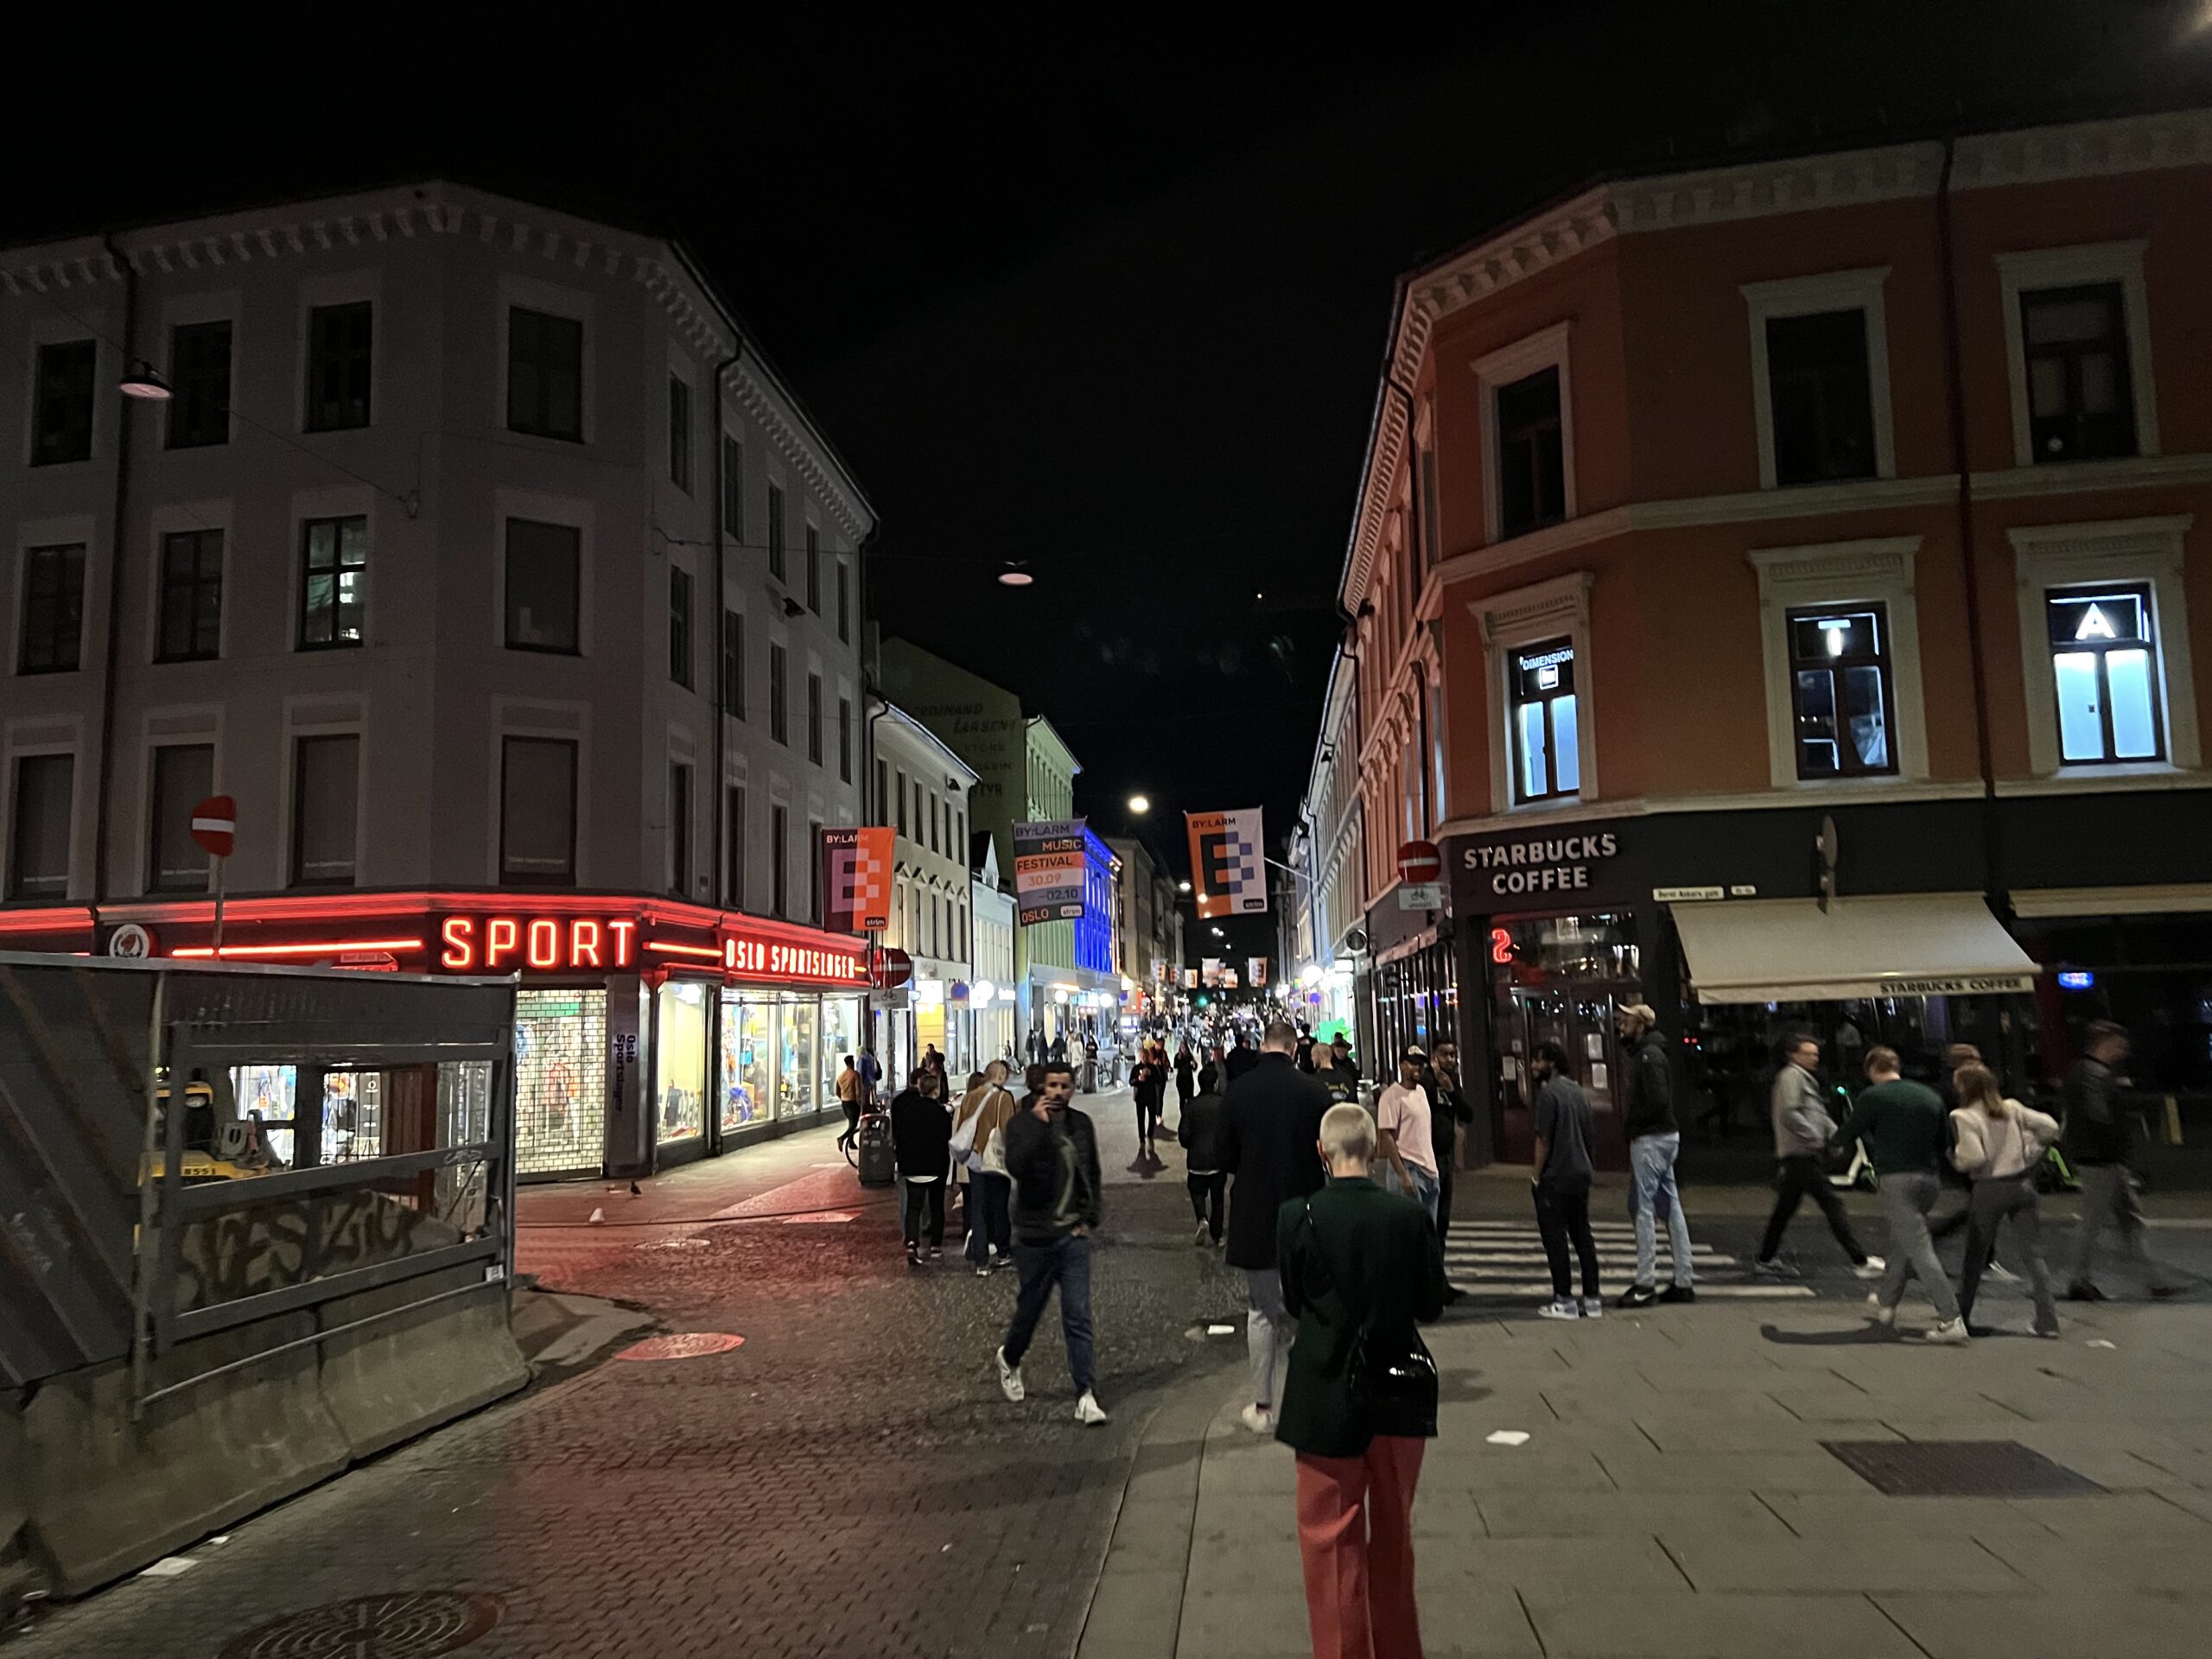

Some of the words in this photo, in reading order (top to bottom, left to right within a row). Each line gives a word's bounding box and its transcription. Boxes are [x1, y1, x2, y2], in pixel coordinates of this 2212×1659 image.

[1015, 824, 1070, 837] BY:LARM
[1192, 817, 1236, 829] BY:LARM
[1042, 839, 1082, 852] MUSIC
[1464, 834, 1617, 870] STARBUCKS
[1017, 856, 1073, 872] FESTIVAL
[1028, 873, 1062, 887] 30.09
[1492, 866, 1588, 895] COFFEE
[1021, 908, 1049, 924] OSLO
[442, 917, 636, 968] SPORT
[726, 938, 765, 970] OSLO
[771, 944, 855, 979] SPORTSLAGER
[1879, 978, 1965, 995] STARBUCKS
[1968, 976, 2023, 991] COFFEE
[626, 1034, 636, 1064] Oslo
[613, 1033, 626, 1113] Sportslager
